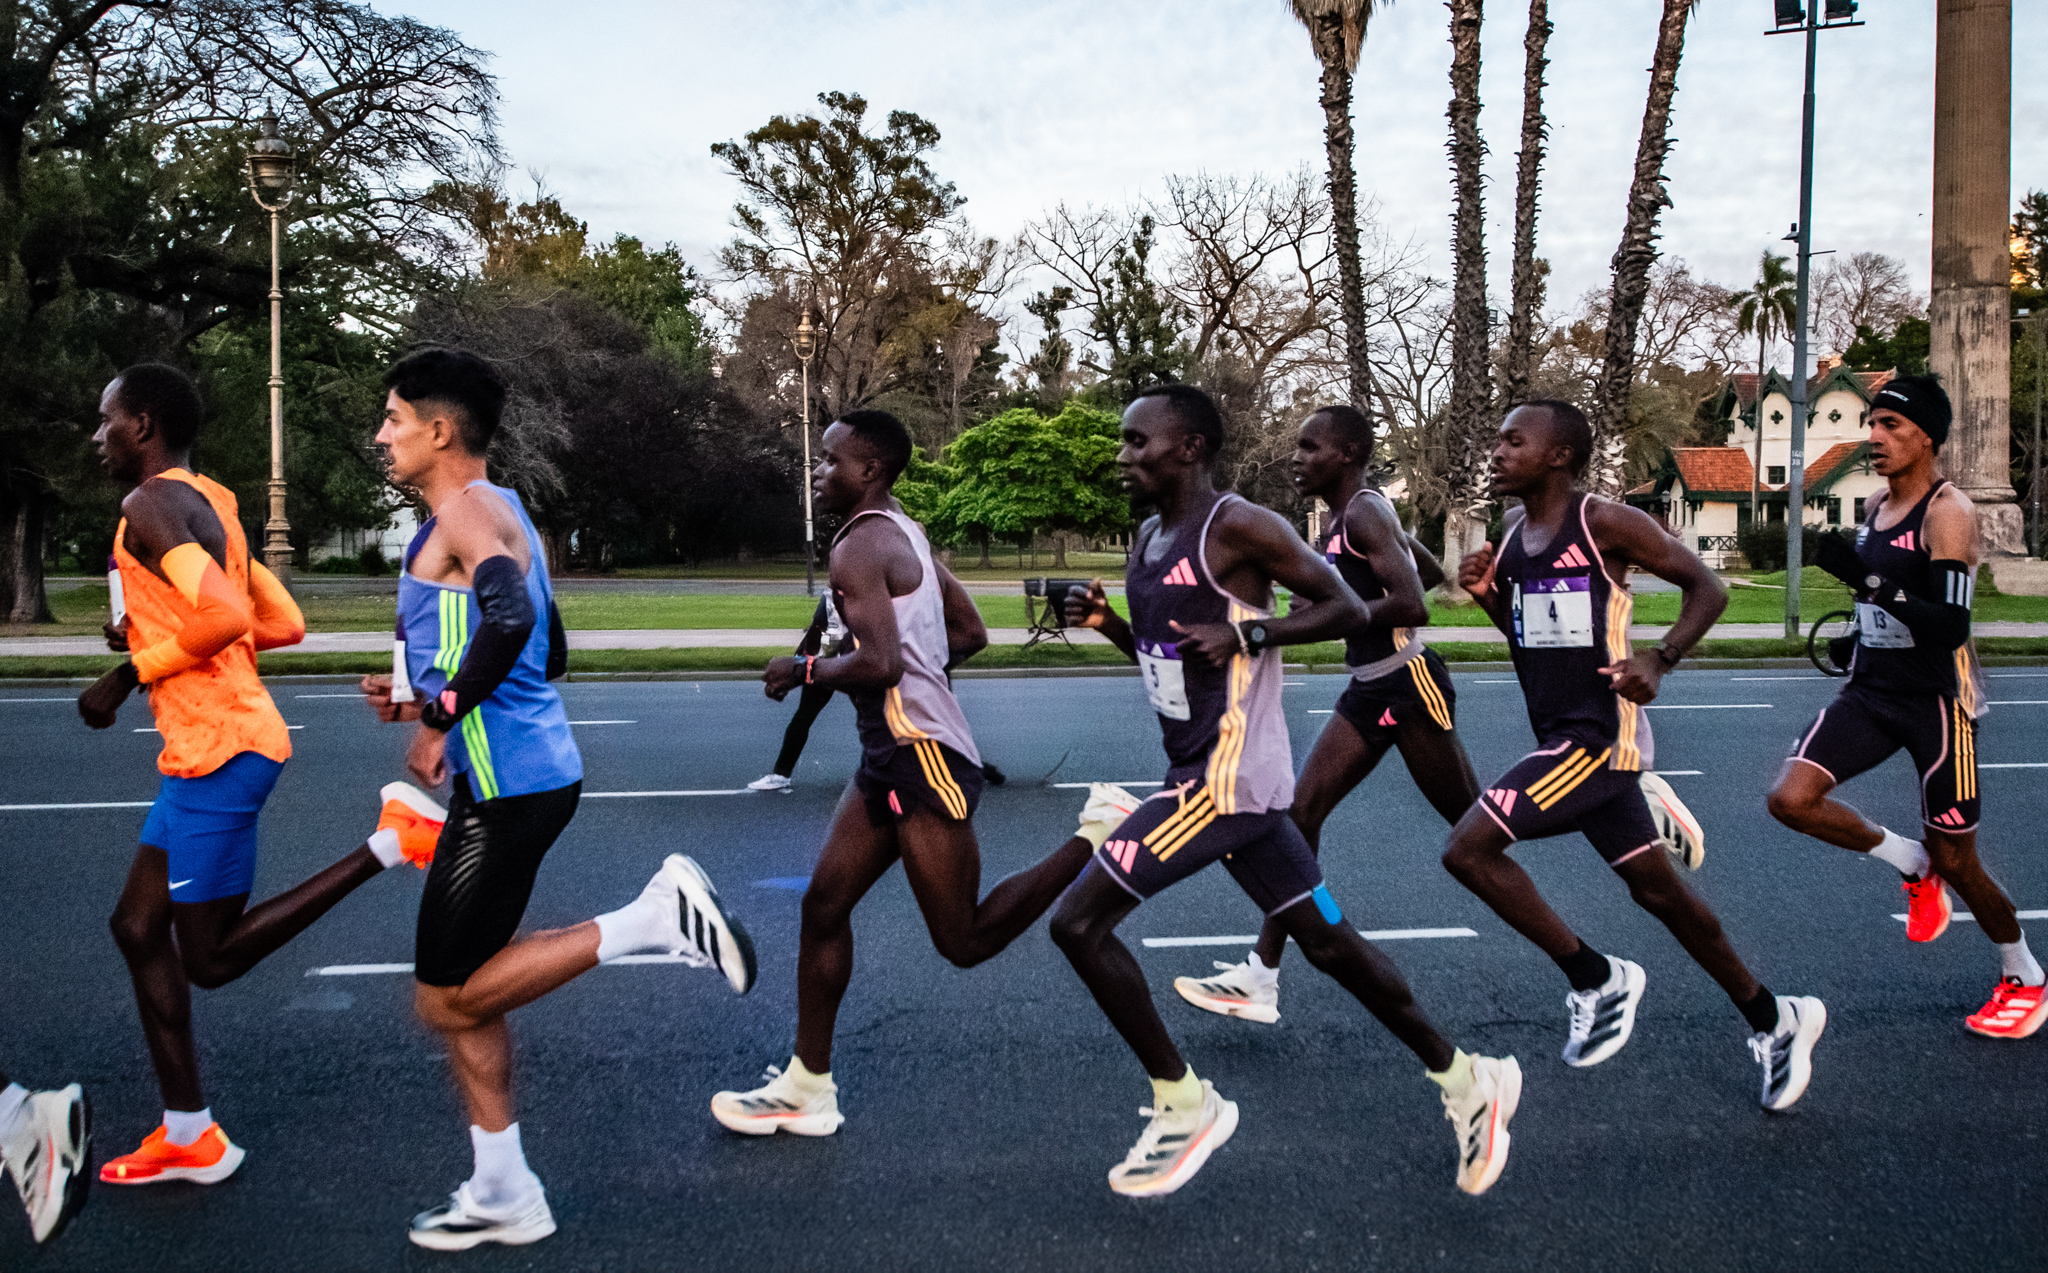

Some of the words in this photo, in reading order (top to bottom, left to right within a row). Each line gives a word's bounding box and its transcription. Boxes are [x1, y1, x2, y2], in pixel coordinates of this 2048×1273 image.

[1549, 600, 1558, 623] 4
[1873, 610, 1887, 629] 13
[1150, 663, 1160, 688] 5
